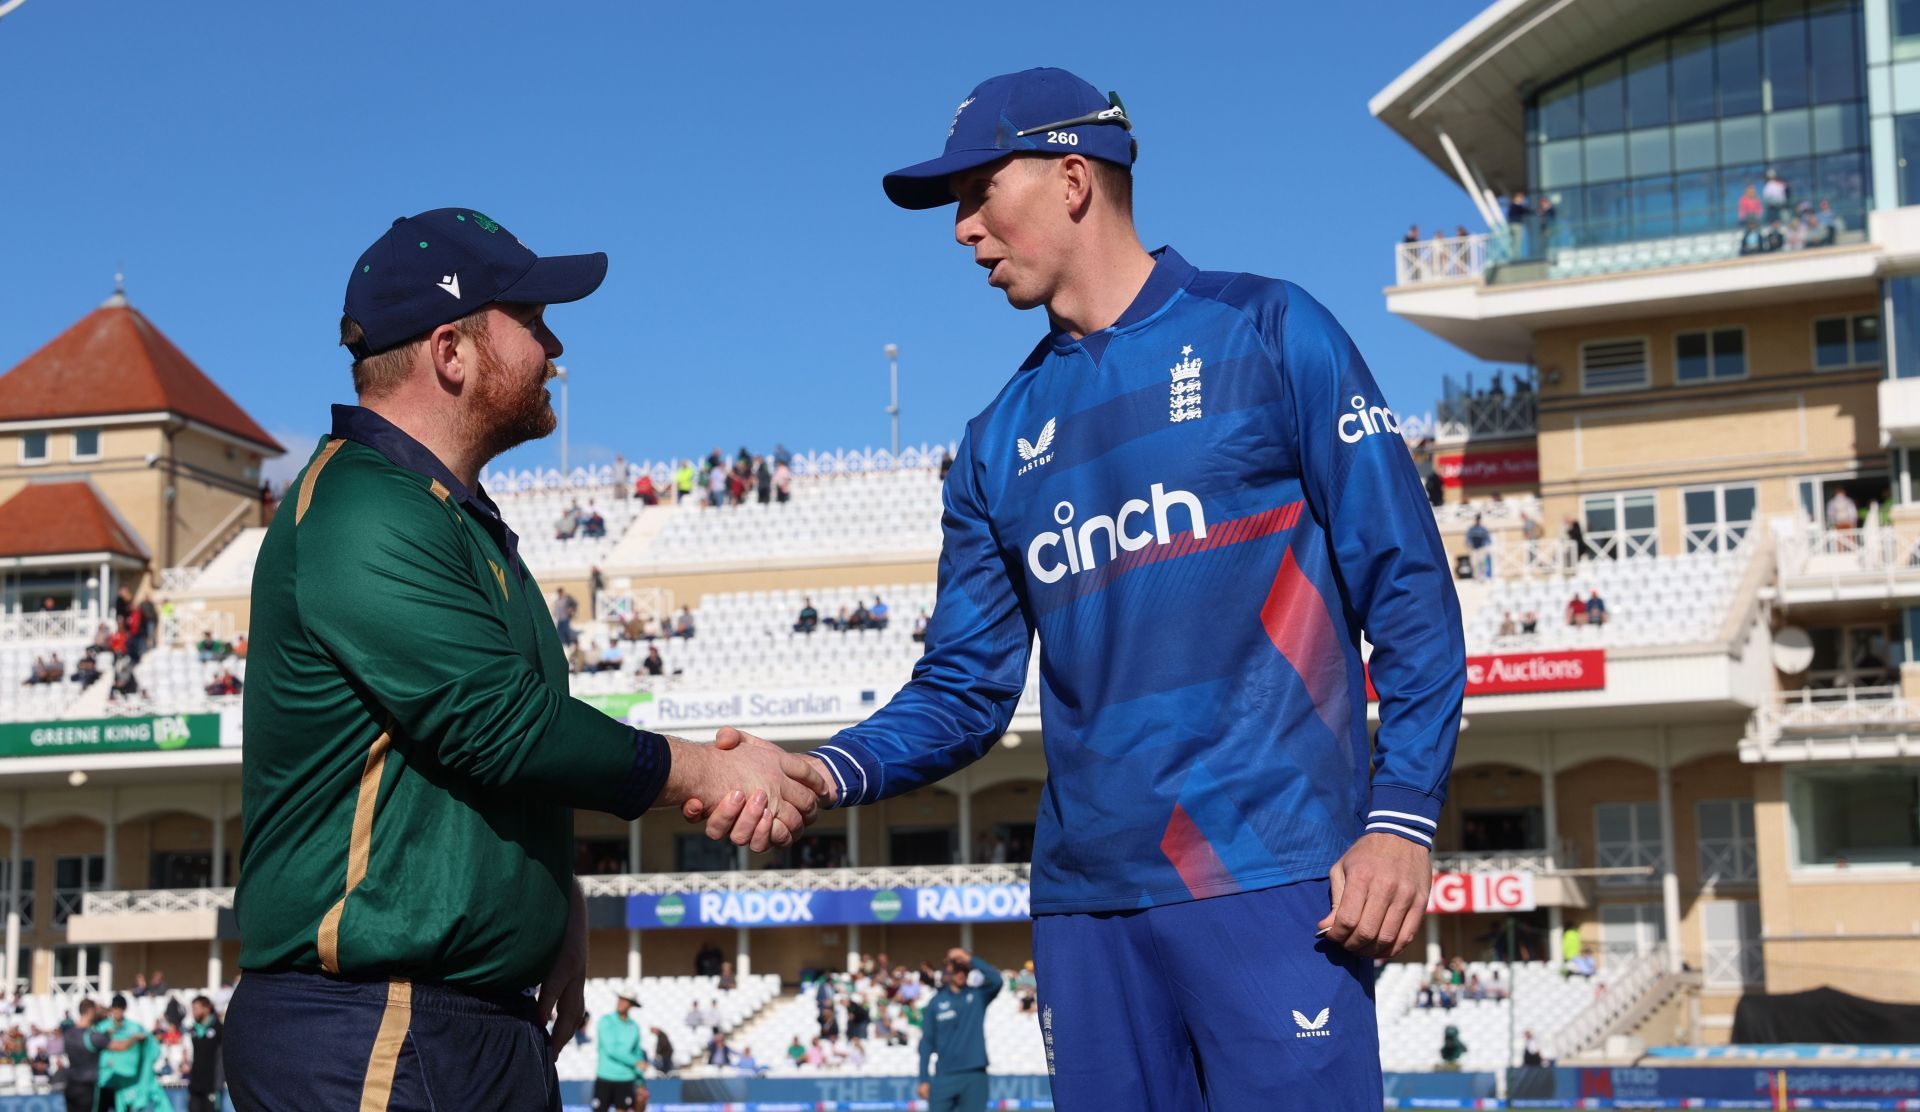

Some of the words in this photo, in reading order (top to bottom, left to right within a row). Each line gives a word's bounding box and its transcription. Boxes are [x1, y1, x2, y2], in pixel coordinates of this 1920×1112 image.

[1047, 131, 1079, 146] 260
[1027, 482, 1208, 585] cinch
[1487, 656, 1584, 683] Auctions
[658, 692, 743, 721] Russell
[749, 690, 842, 717] Scanlan
[30, 727, 100, 747] GREENE
[103, 723, 151, 742] KING
[1484, 875, 1523, 908] IG
[700, 892, 814, 926] RADOX
[916, 886, 1031, 922] RADOX
[1296, 1030, 1331, 1038] CASTORE
[816, 1080, 879, 1101] THE
[989, 1078, 1049, 1101] WIL
[1754, 1069, 1919, 1096] Pople-people
